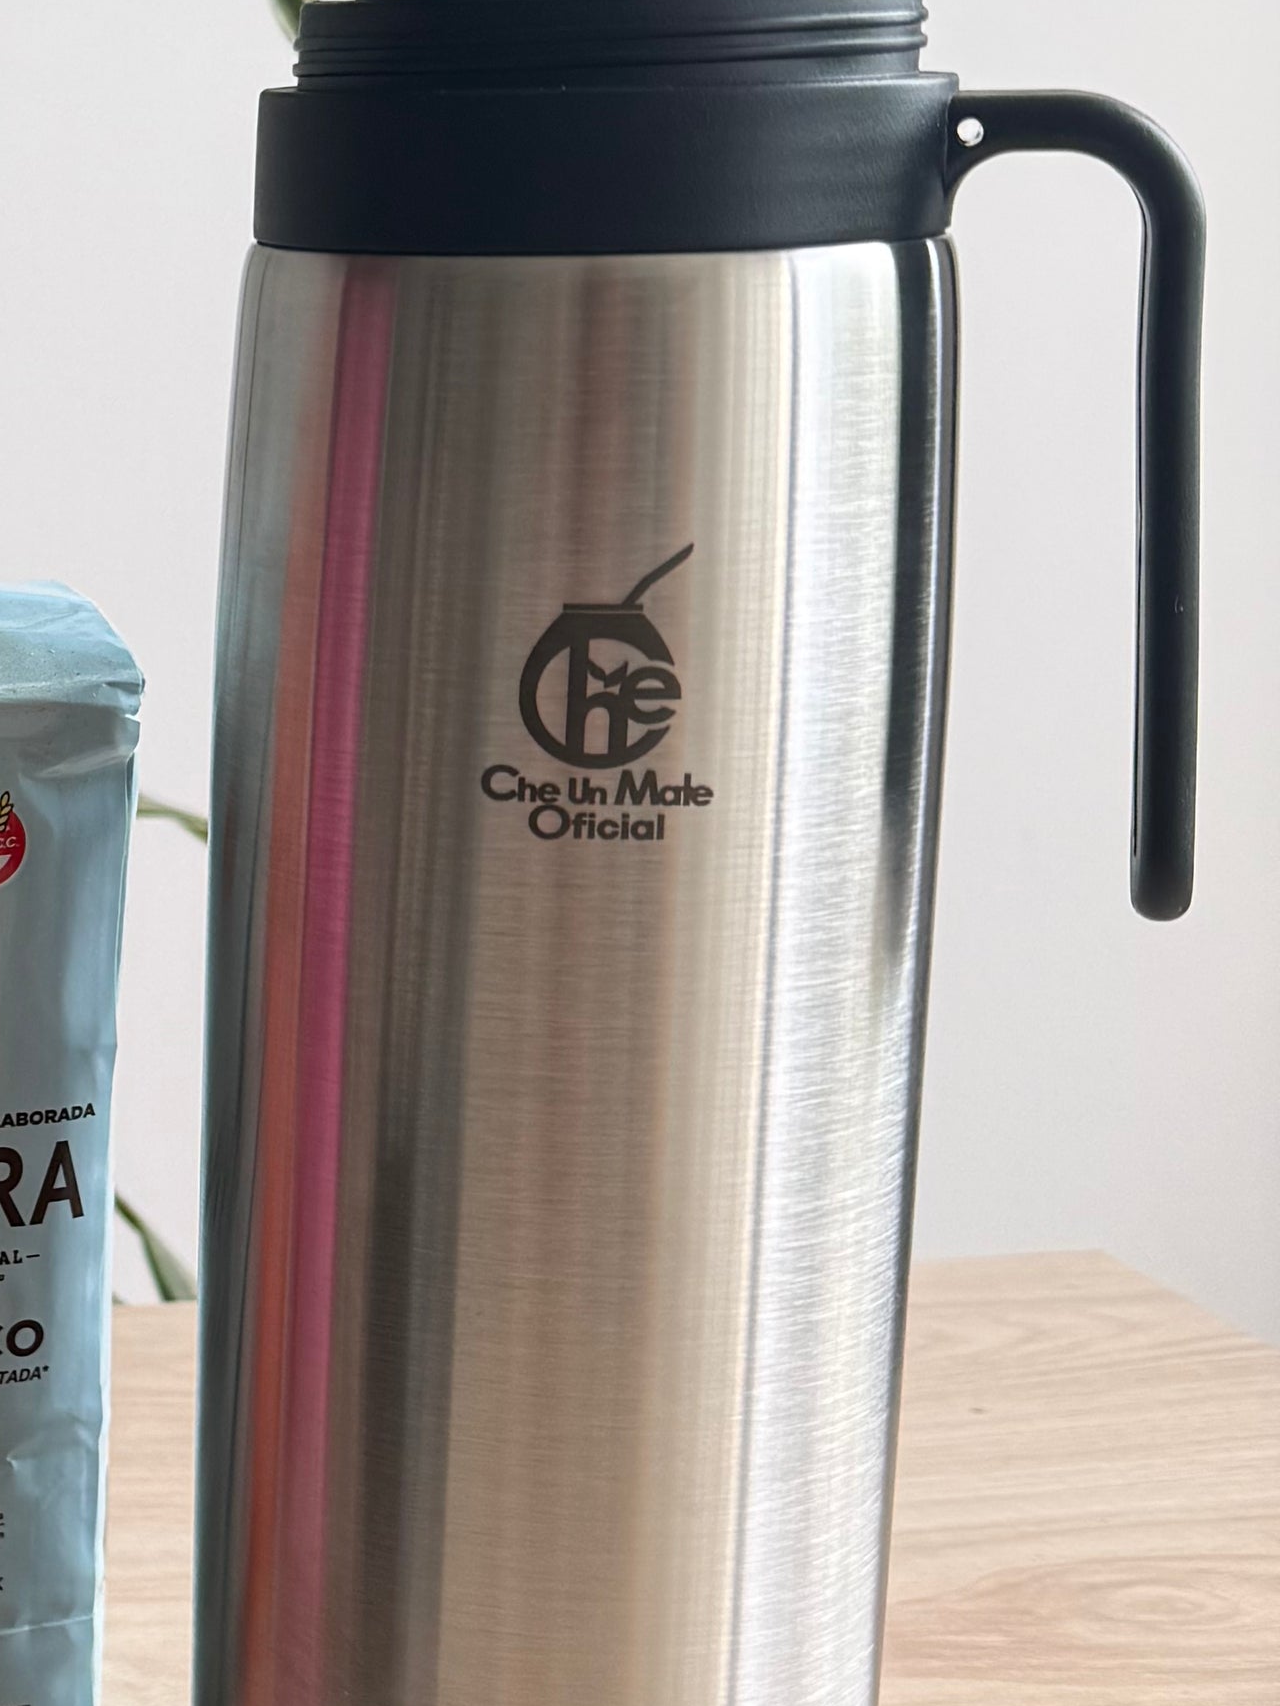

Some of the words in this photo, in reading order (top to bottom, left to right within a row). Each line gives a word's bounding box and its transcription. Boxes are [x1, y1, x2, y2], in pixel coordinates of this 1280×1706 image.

[480, 764, 561, 803] Che
[568, 777, 607, 805] Un
[614, 769, 714, 806] Mate
[528, 805, 664, 840] Oficial
